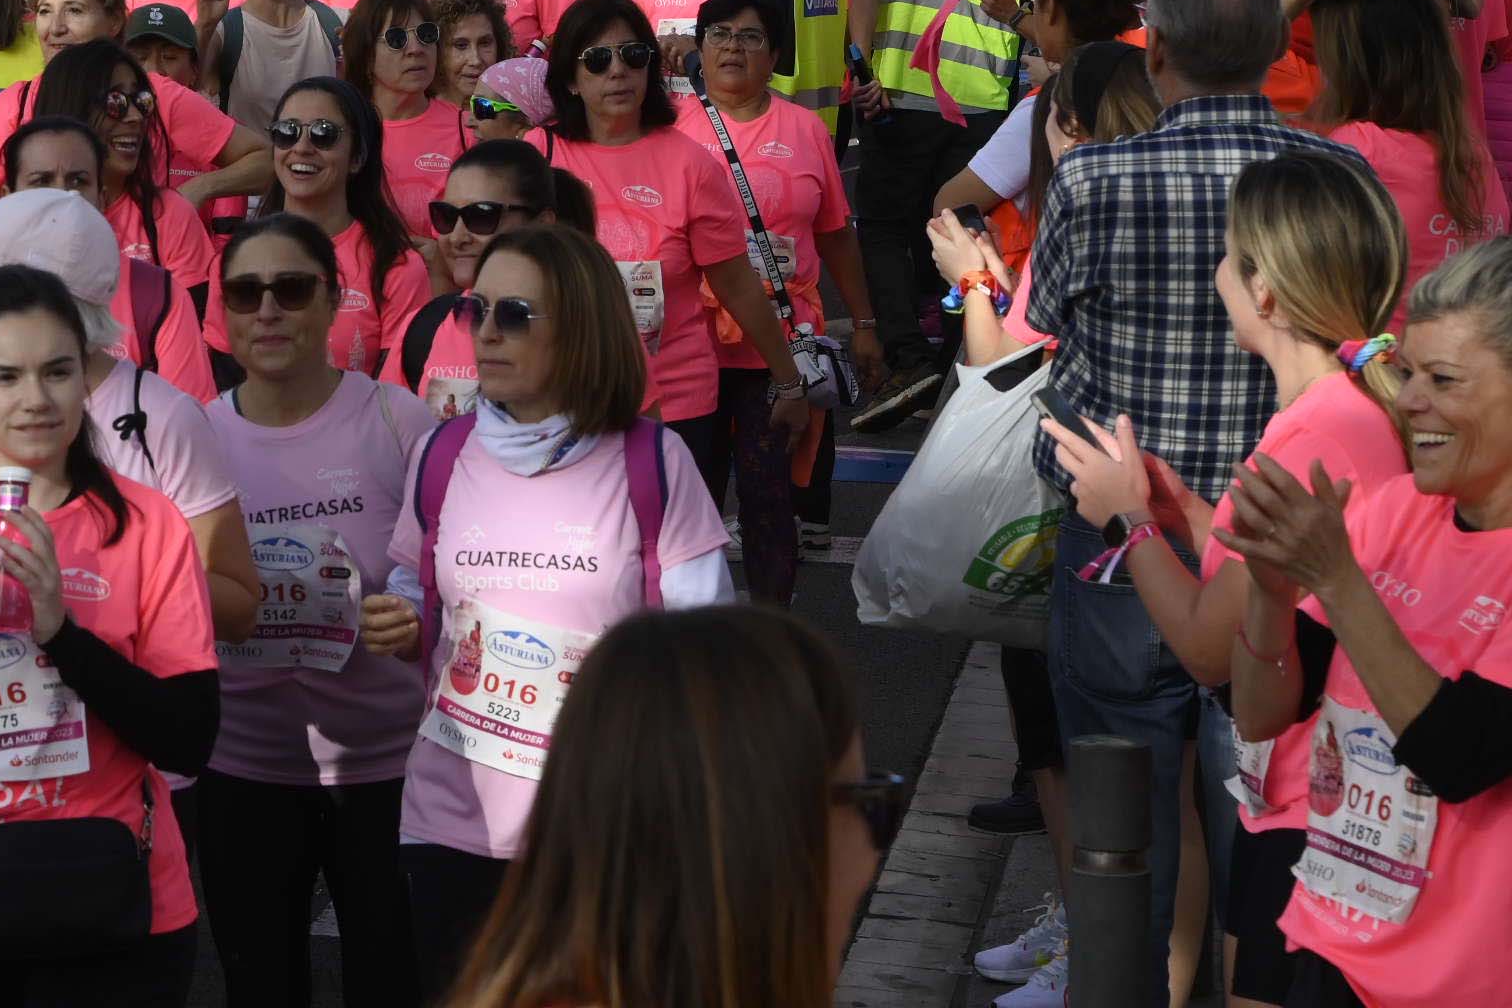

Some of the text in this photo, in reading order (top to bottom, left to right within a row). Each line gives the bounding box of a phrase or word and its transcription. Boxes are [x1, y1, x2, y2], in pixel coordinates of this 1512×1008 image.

[249, 496, 364, 524] ATRECASAS
[455, 550, 599, 573] CUATRECASAS
[63, 581, 107, 595] TURIANA
[453, 572, 560, 593] Sports Club
[263, 608, 297, 622] 5142
[490, 637, 550, 665] ASTURIANA
[484, 673, 539, 706] 016
[446, 704, 544, 745] CARRERA DE LA MUJER
[487, 701, 521, 723] 5223
[1, 735, 14, 747] LA
[15, 730, 49, 744] MUJER
[439, 721, 477, 748] OYSHO
[24, 750, 80, 768] Santander
[1347, 783, 1392, 822] 016
[1341, 819, 1383, 846] 31878
